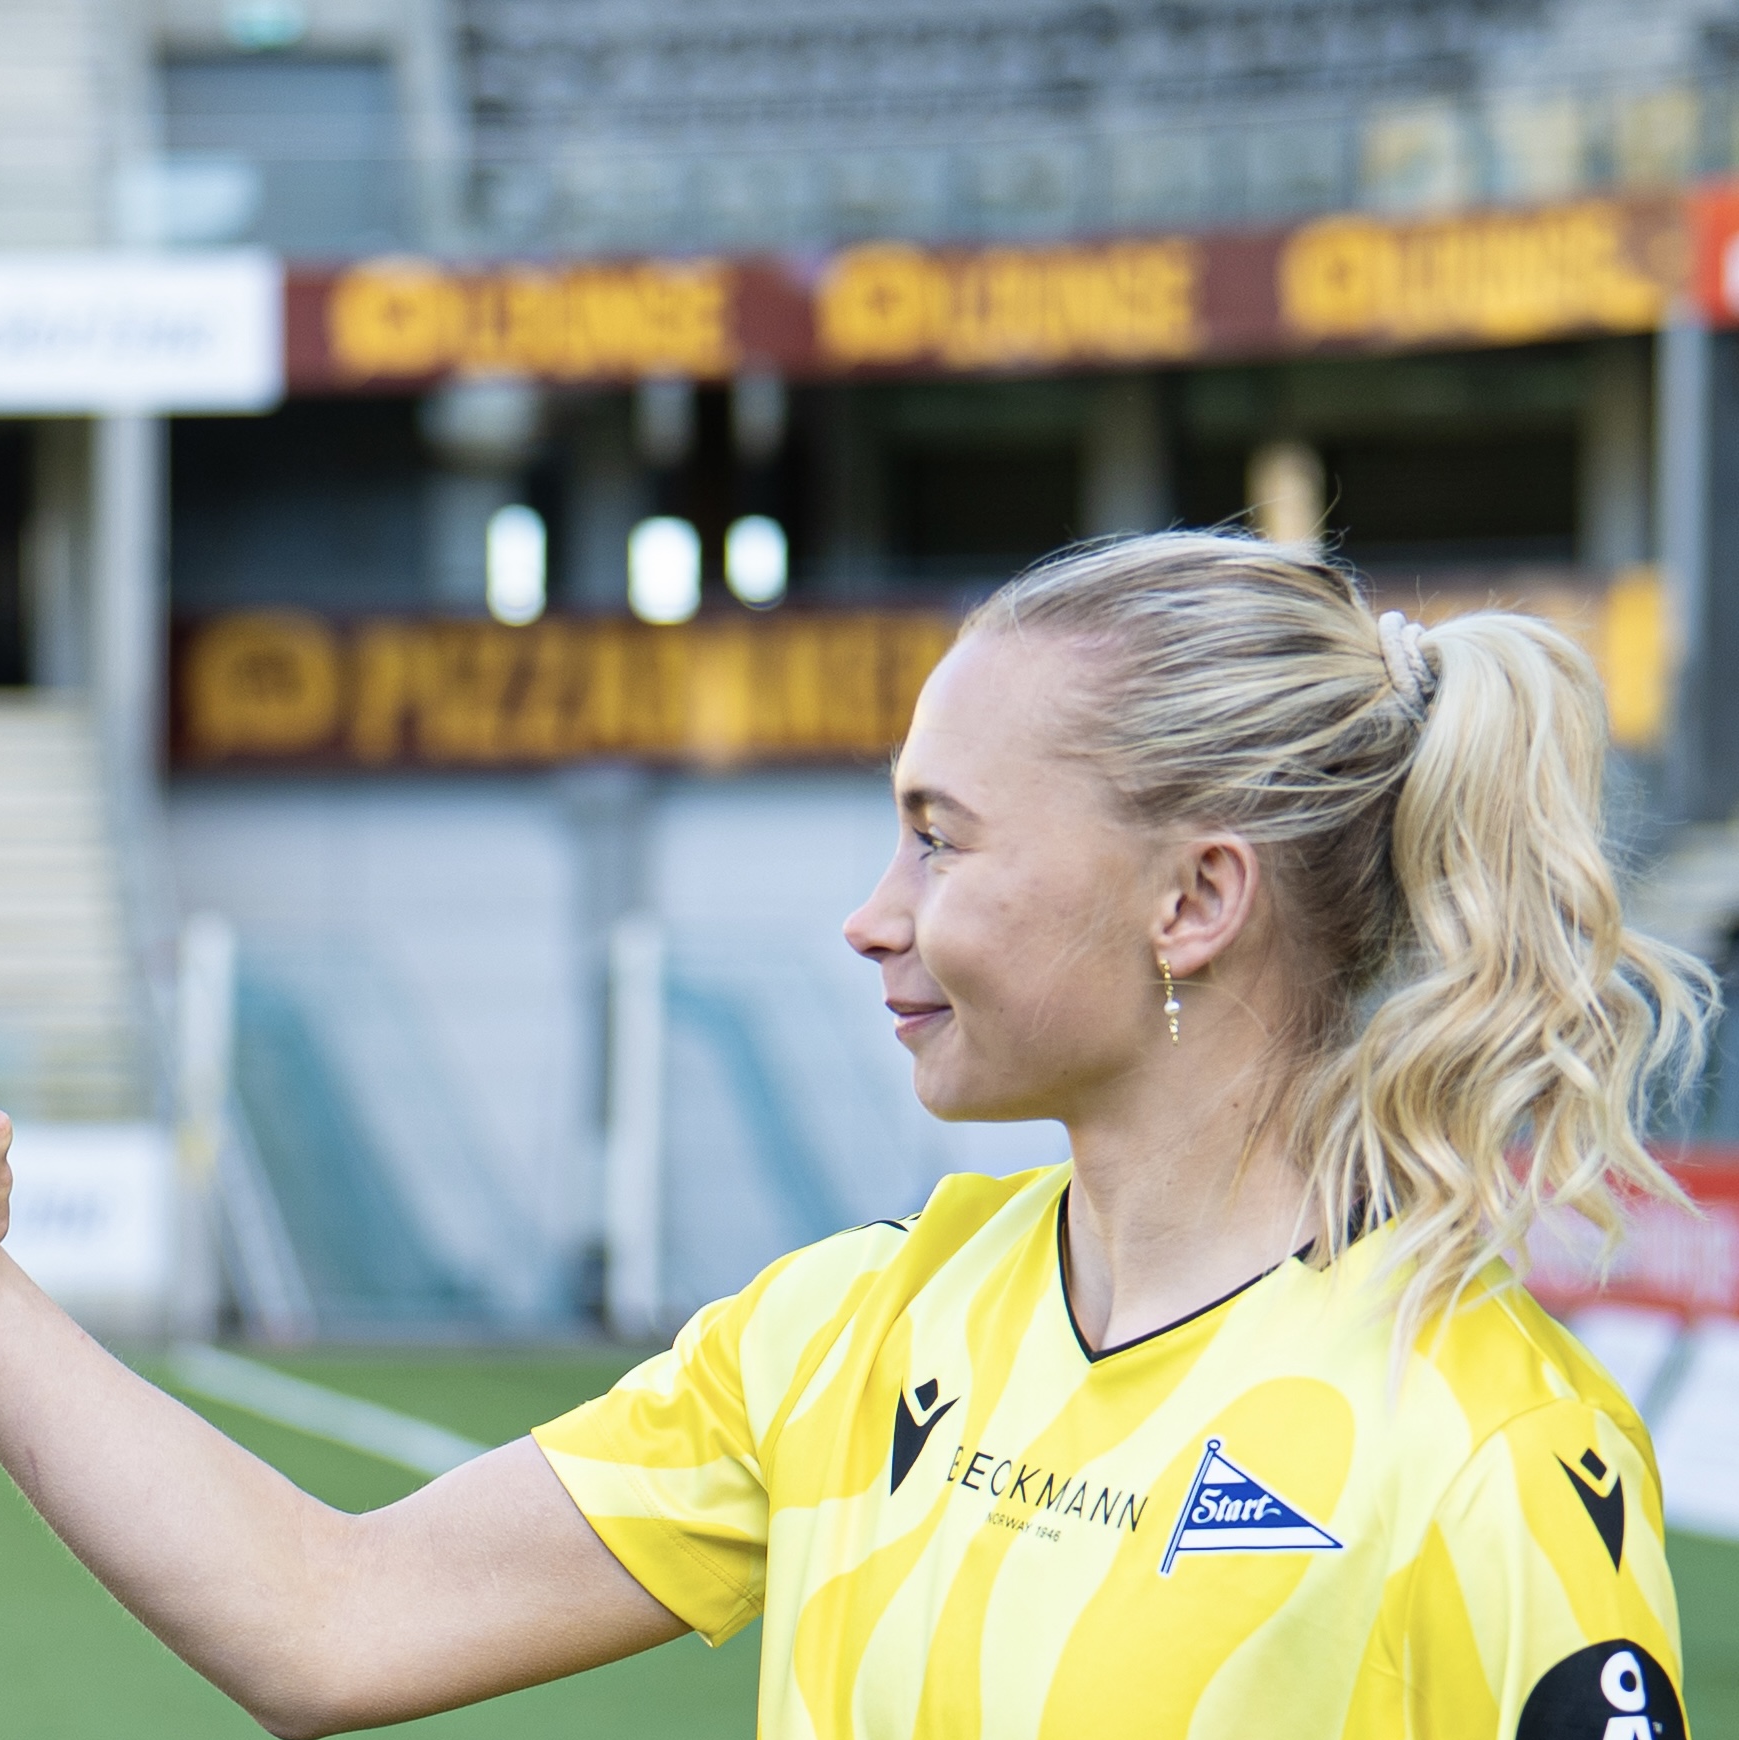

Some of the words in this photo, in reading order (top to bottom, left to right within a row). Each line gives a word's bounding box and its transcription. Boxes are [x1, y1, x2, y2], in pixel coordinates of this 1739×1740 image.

[947, 1446, 1148, 1532] BECKMANN
[1191, 1488, 1282, 1524] Start
[986, 1512, 1033, 1533] NORWAY
[1035, 1526, 1061, 1542] 1946
